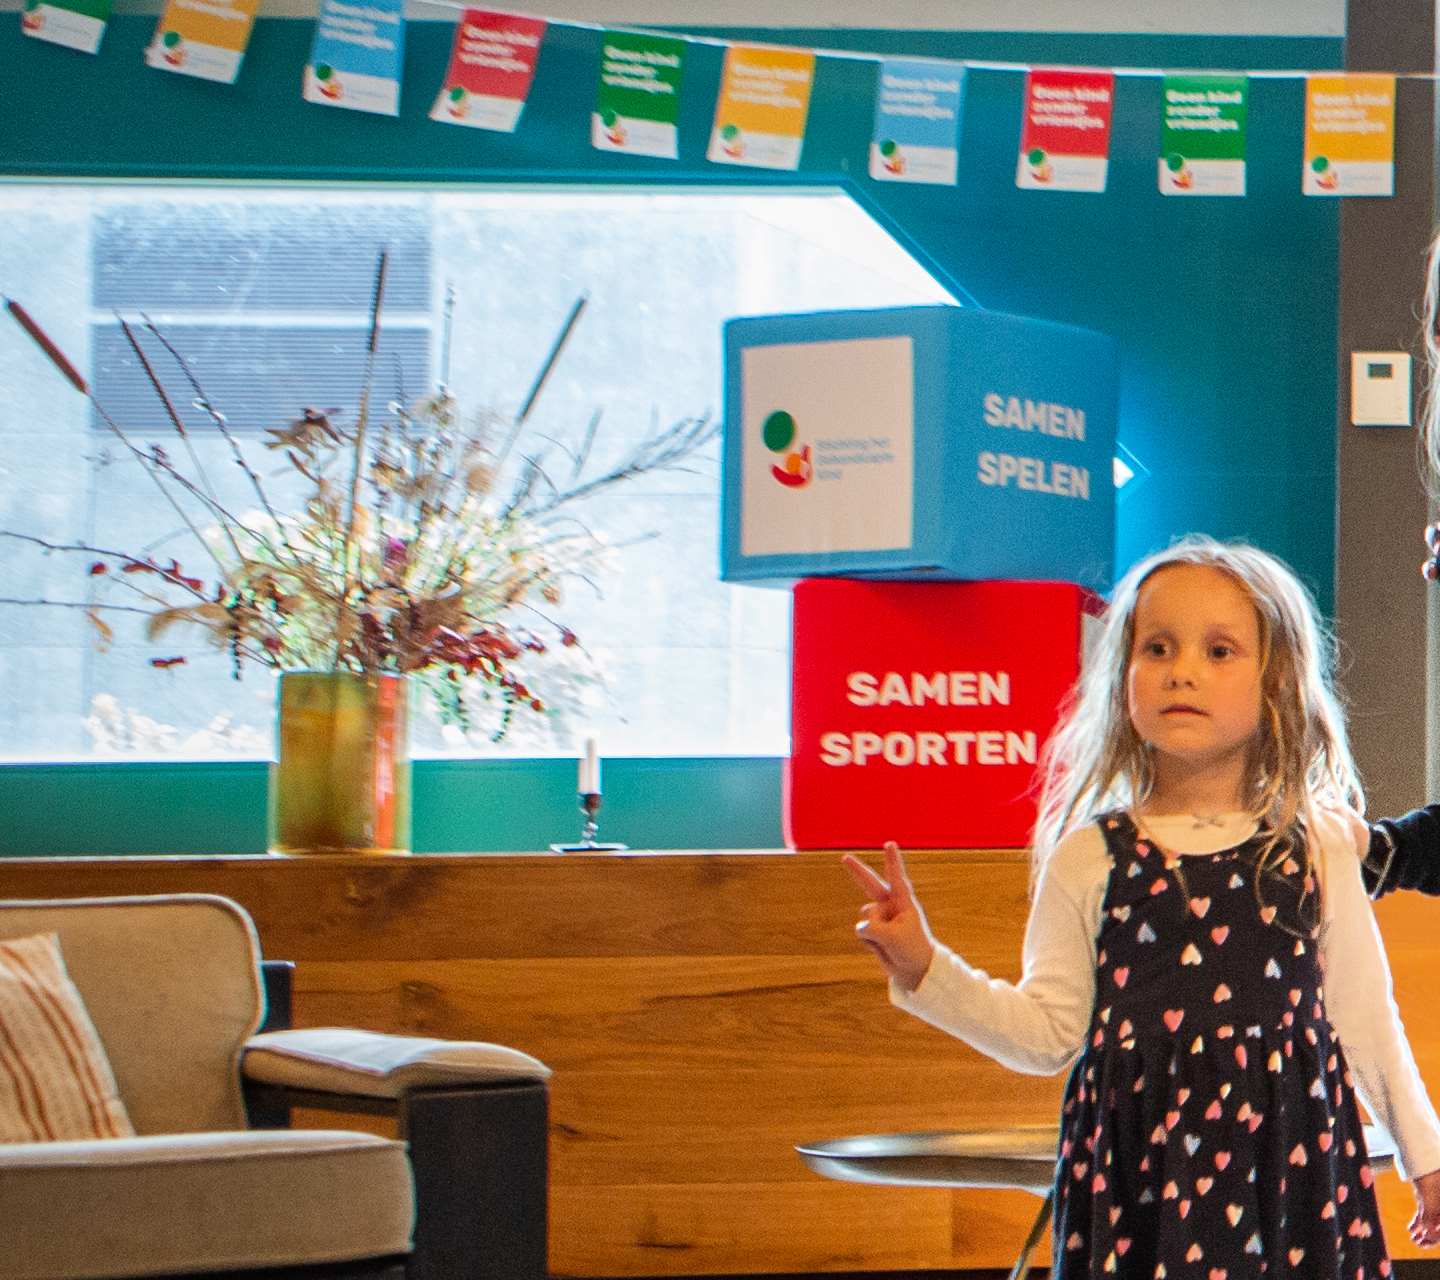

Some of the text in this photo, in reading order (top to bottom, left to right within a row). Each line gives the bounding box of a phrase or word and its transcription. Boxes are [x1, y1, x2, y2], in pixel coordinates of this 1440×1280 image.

[984, 391, 1085, 441] SAMEN
[977, 451, 1090, 501] SPELEN
[846, 671, 1011, 707] SAMEN
[819, 730, 1039, 767] SPORTEN
